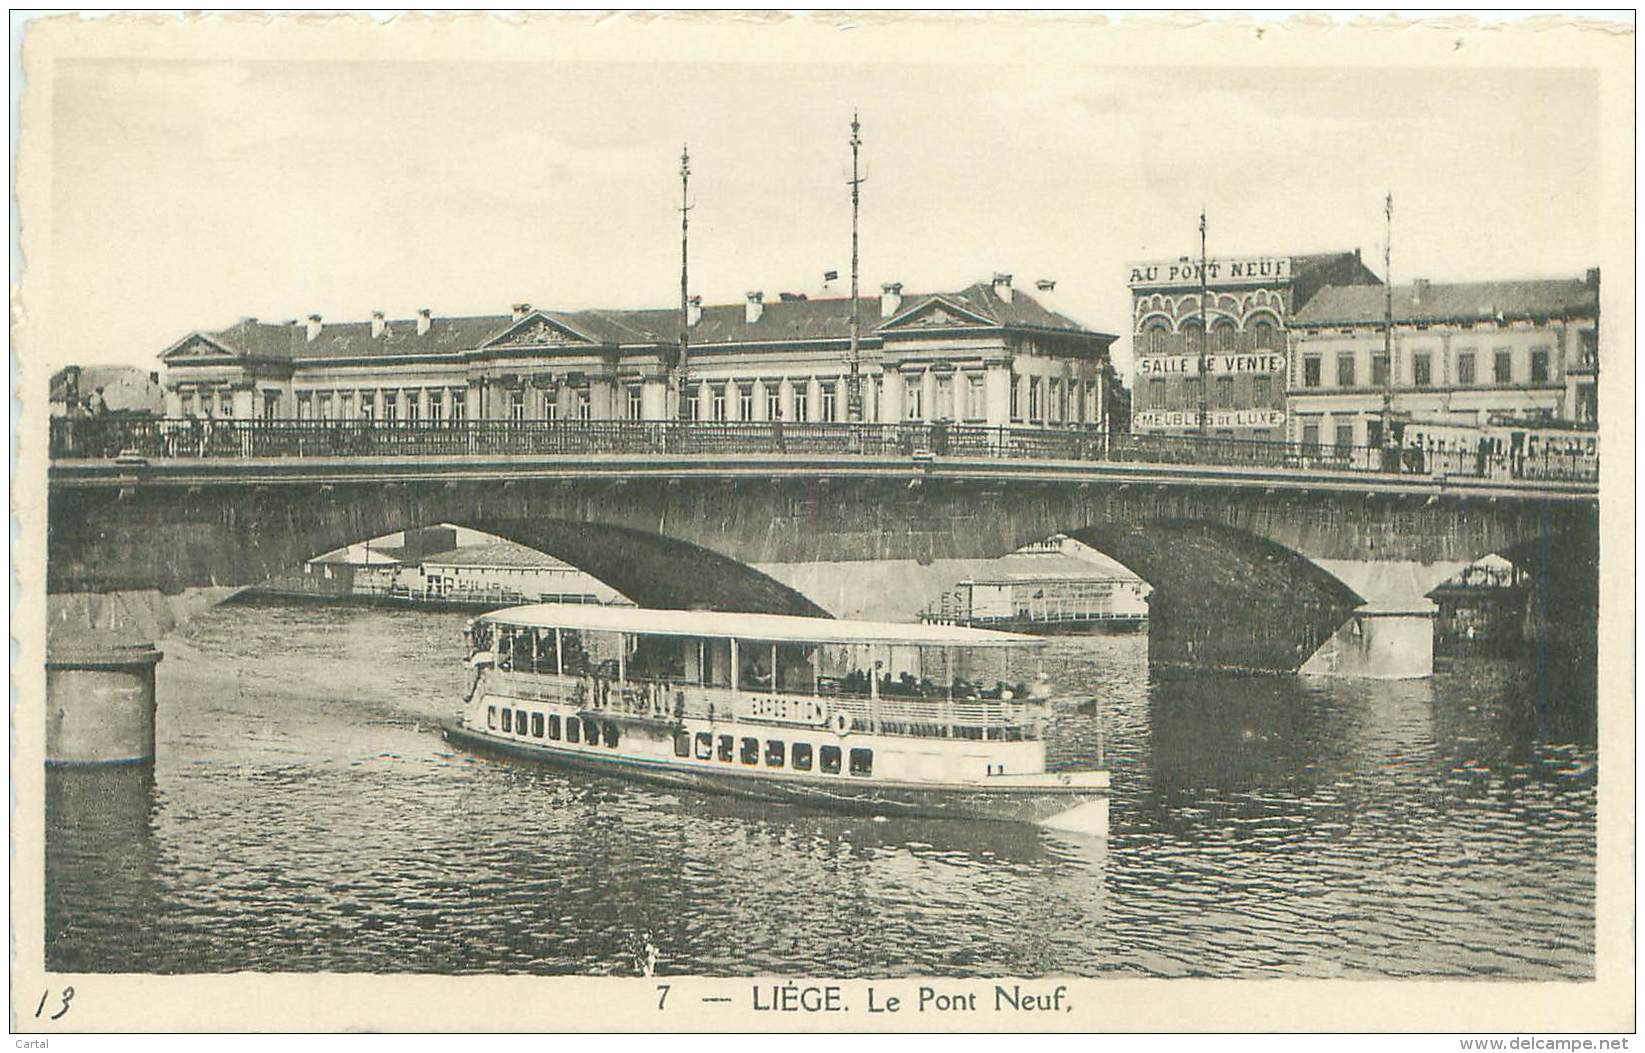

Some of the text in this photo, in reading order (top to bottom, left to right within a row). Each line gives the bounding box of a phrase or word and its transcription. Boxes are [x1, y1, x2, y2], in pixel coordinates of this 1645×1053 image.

[1130, 261, 1285, 282] AU PONT NEUF
[1142, 356, 1279, 374] SALLE E VENTE
[1142, 411, 1213, 426] MEUBLES
[1237, 411, 1278, 426] LUXE
[35, 986, 75, 1020] 13
